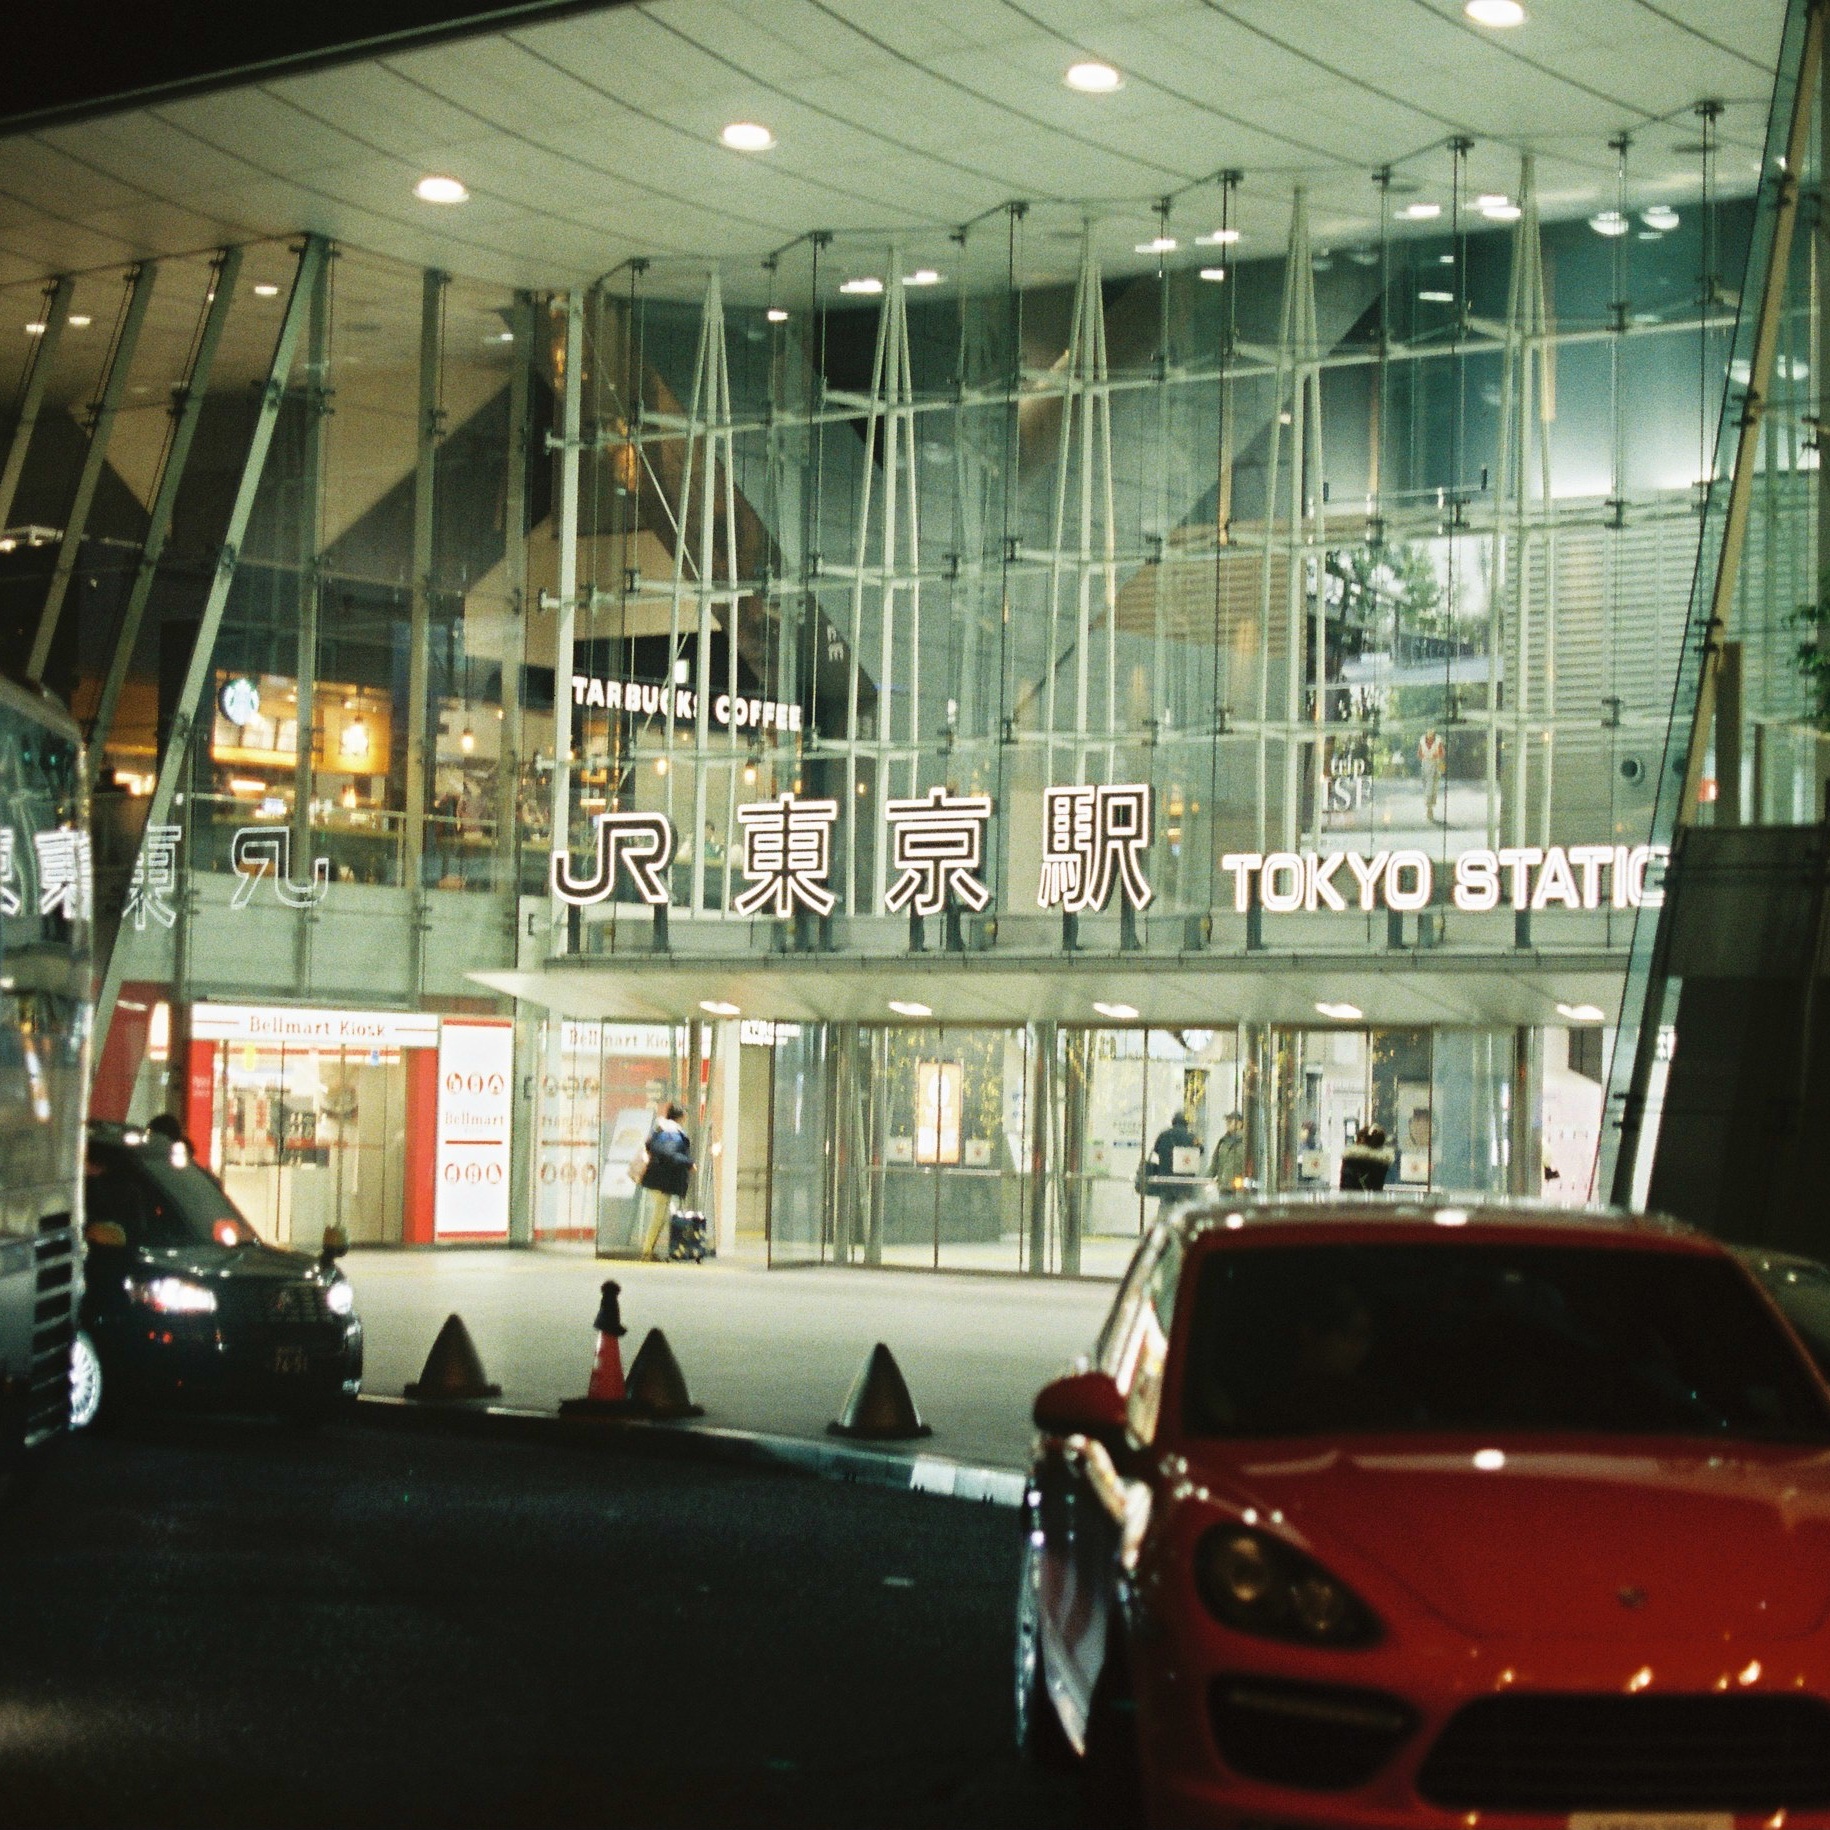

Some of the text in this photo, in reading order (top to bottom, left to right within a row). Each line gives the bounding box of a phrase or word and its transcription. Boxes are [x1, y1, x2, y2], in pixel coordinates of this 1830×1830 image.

[715, 694, 801, 732] COFFEE
[551, 784, 1153, 918] JR 東京駅
[1222, 851, 1432, 913] TOKYO
[250, 1015, 385, 1037] Bellmart Kiosk
